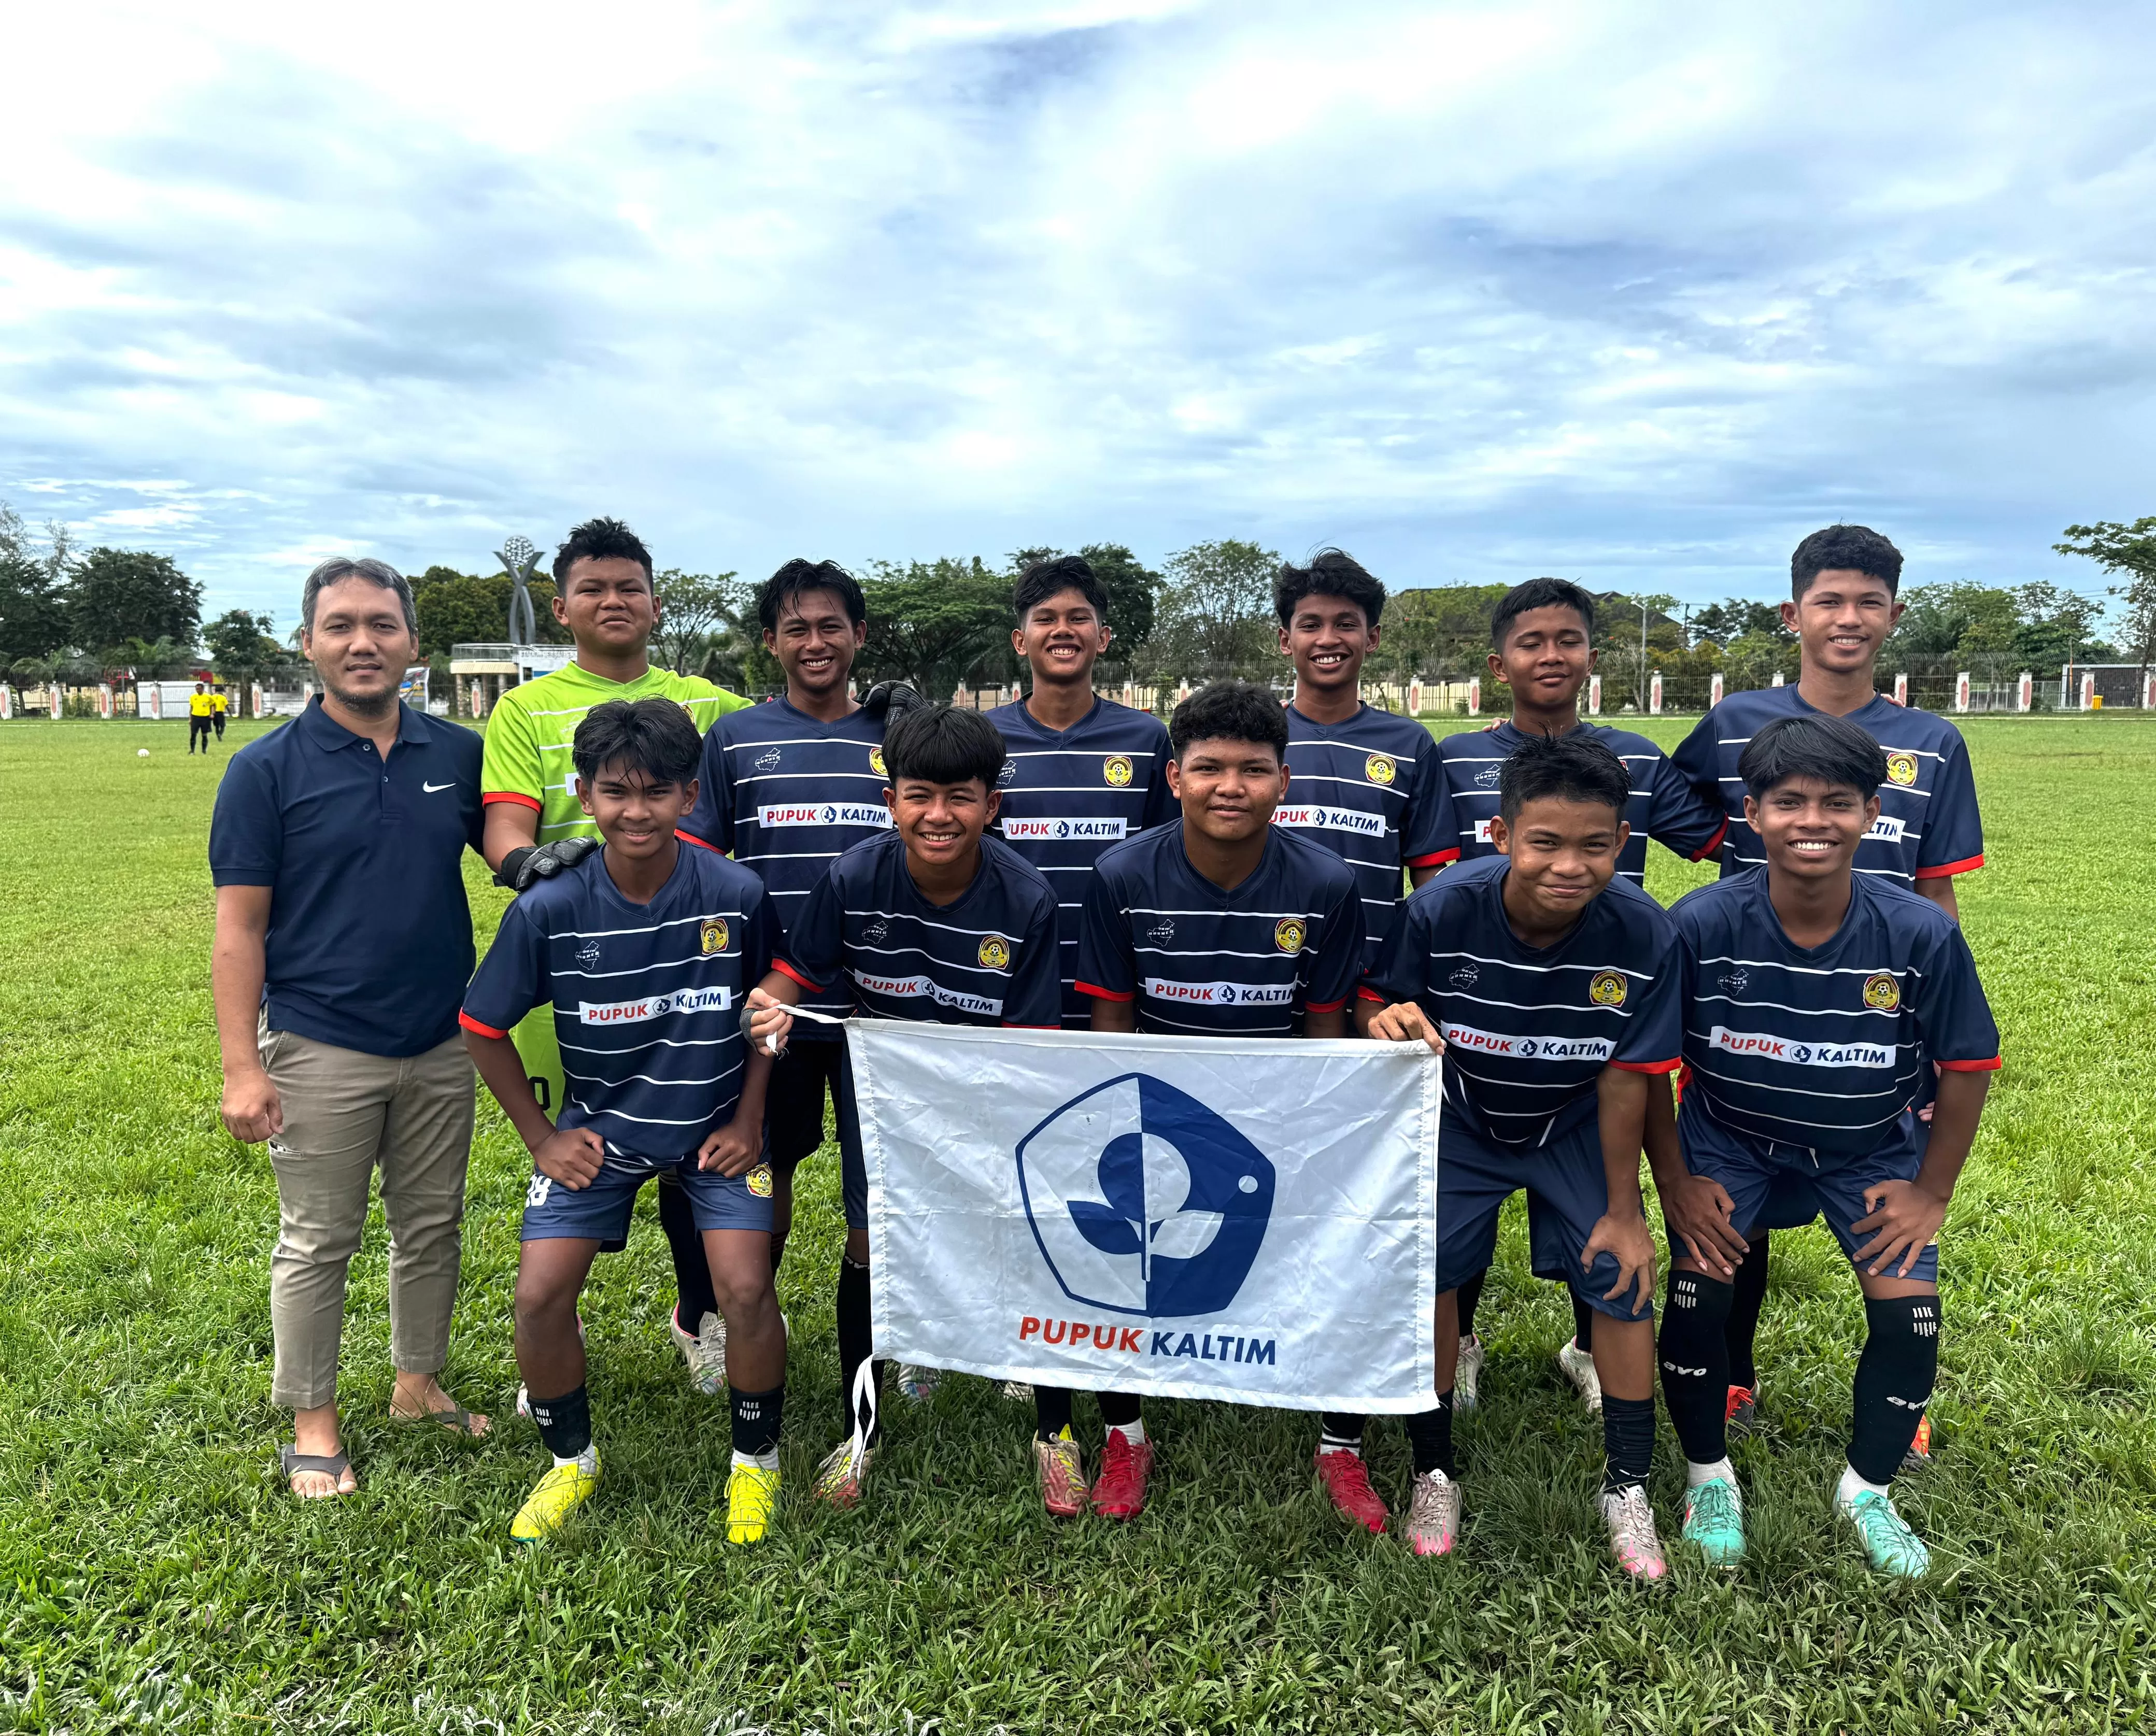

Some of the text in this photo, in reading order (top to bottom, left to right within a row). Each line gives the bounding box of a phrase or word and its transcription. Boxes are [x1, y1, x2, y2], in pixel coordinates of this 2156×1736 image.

[767, 808, 886, 823] PUPUK KALTIM
[1330, 813, 1379, 832] KALTIM
[1009, 823, 1120, 835] UPUK KALTIM
[862, 977, 993, 1012] PUPUK KALTIM
[1155, 984, 1213, 1000] PUPUK
[589, 1004, 648, 1021] PUPUK
[1449, 1030, 1607, 1057] PUPUK KALTIM
[1721, 1032, 1885, 1063] PUPUK KALTIM
[1019, 1316, 1275, 1365] PUPUK KALTIM
